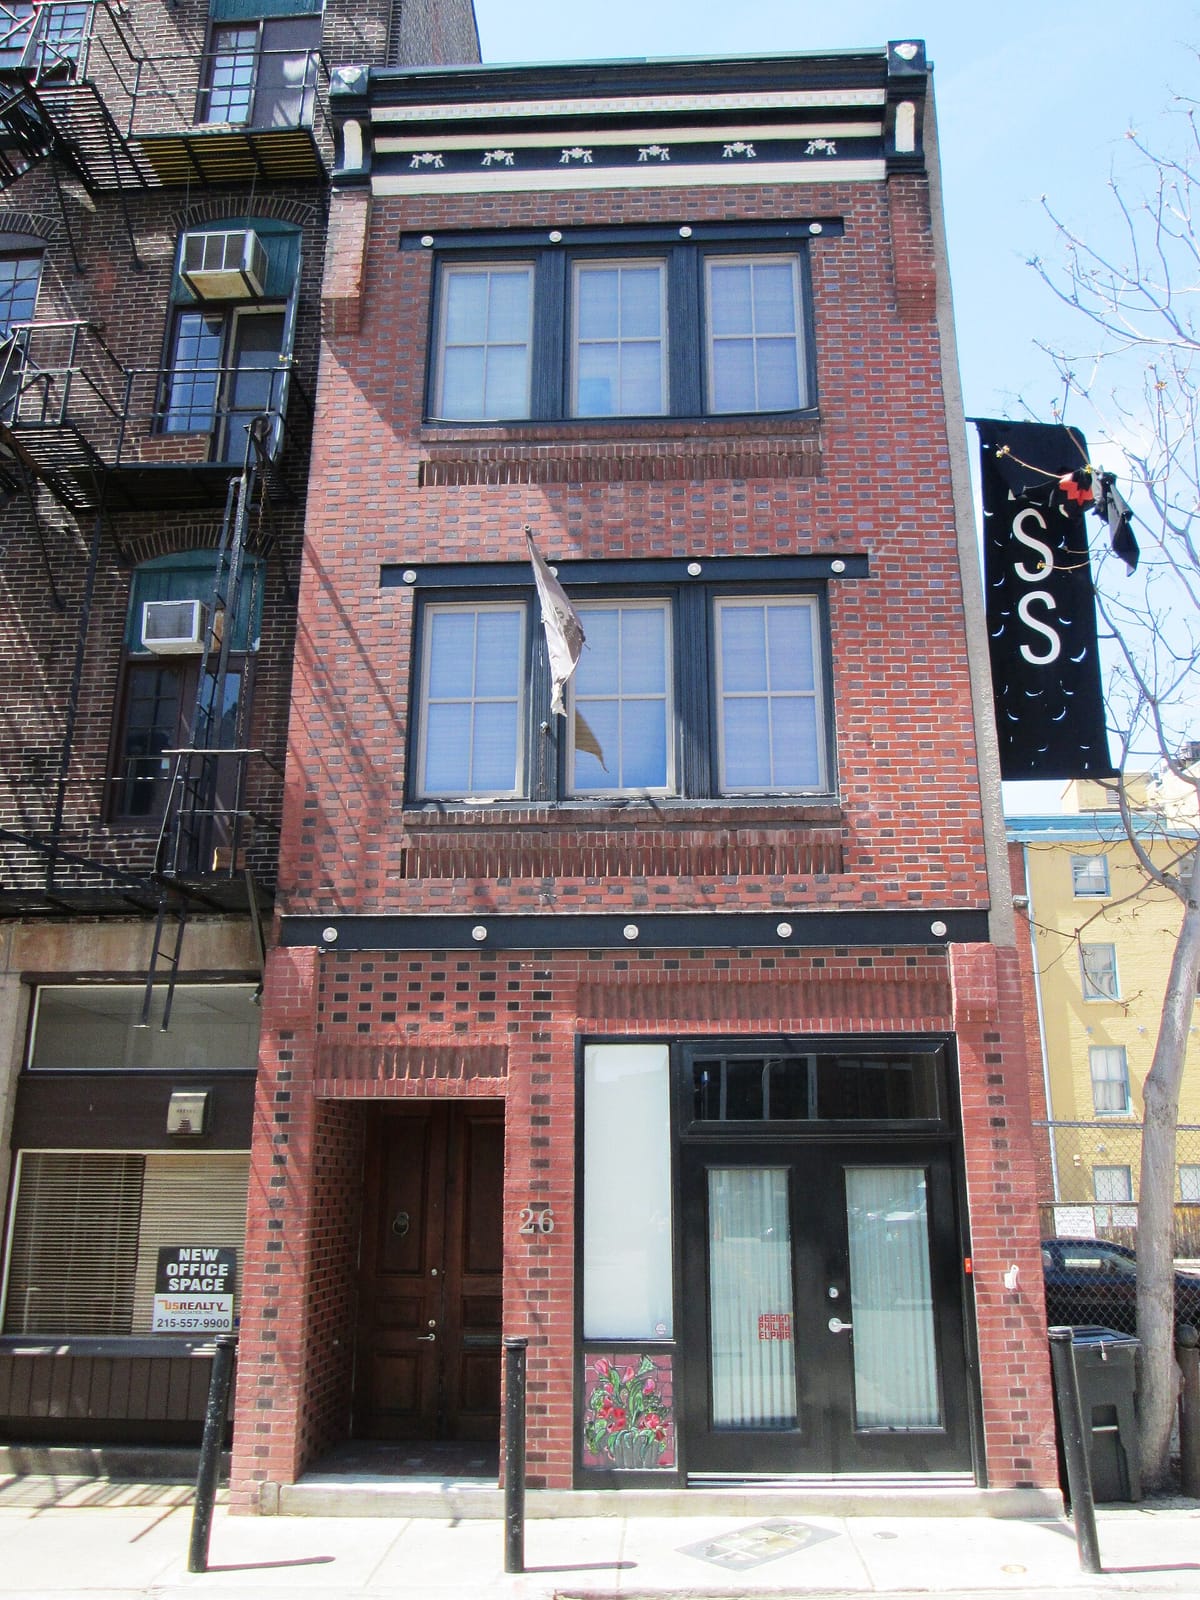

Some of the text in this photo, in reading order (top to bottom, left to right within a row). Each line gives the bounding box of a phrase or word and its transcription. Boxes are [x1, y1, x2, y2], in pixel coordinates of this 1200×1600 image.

[1008, 490, 1063, 665] SS
[519, 1208, 554, 1234] 26
[179, 1248, 219, 1261] NEW
[166, 1263, 229, 1276] OFFICE
[168, 1278, 225, 1291] SPACE
[157, 1318, 230, 1328] 215-557-9900
